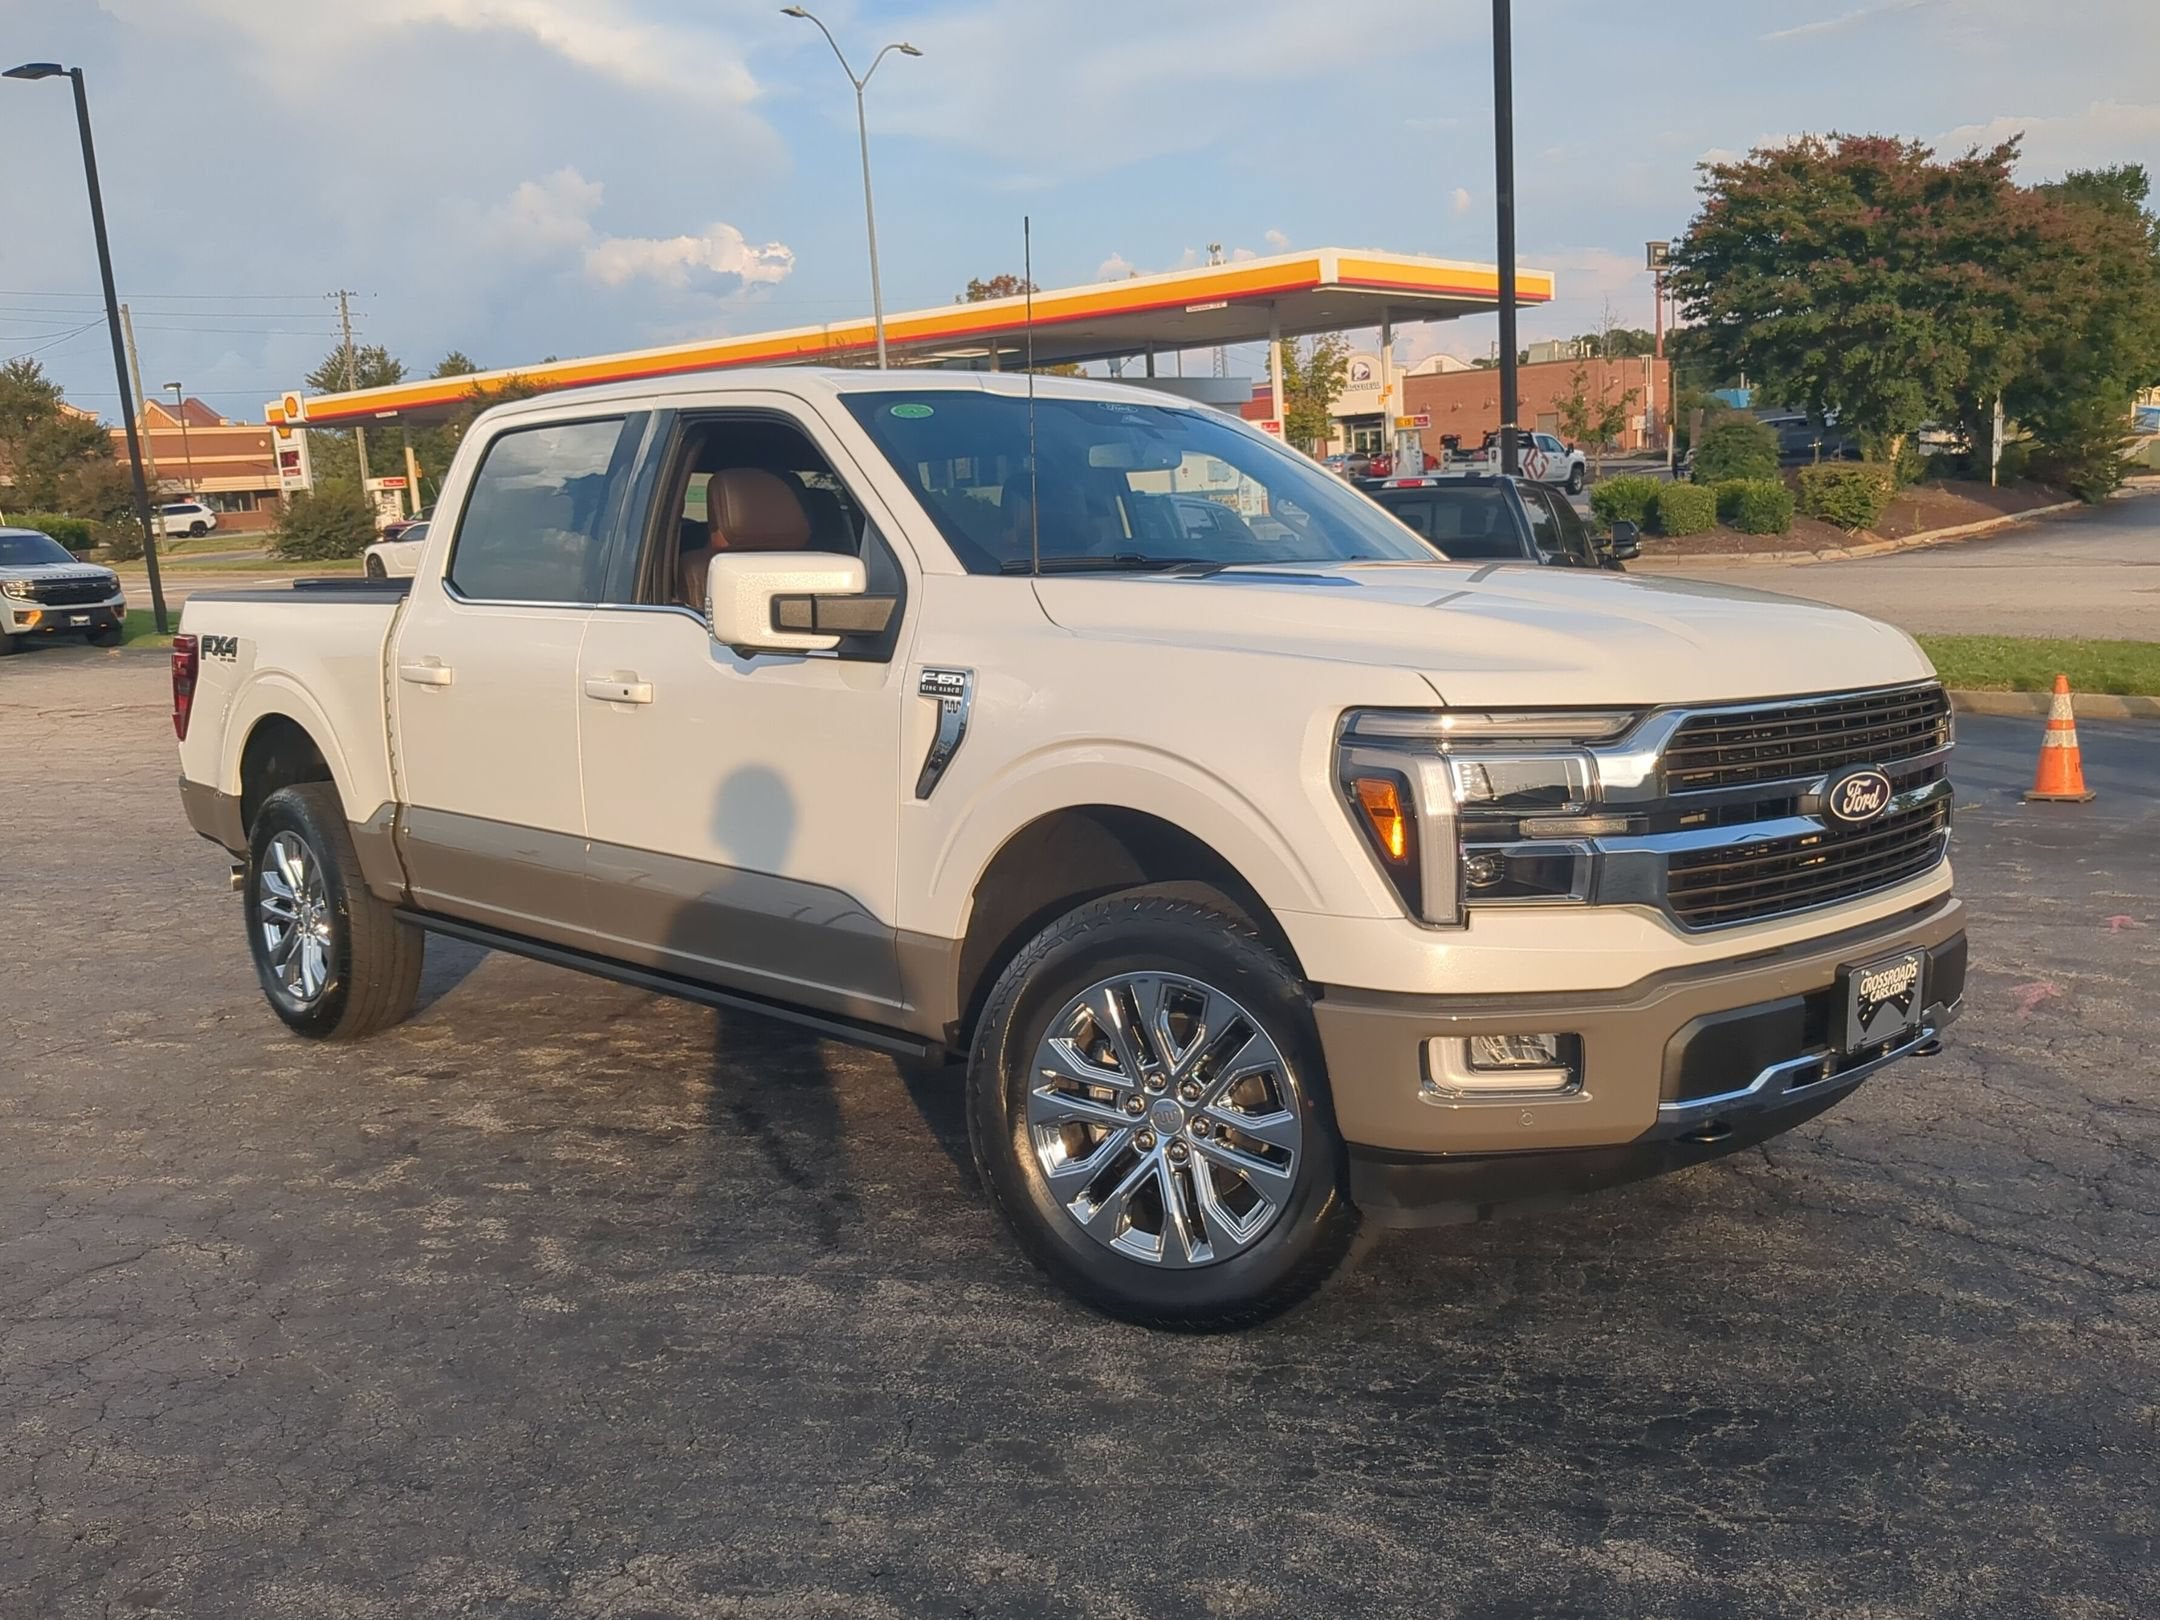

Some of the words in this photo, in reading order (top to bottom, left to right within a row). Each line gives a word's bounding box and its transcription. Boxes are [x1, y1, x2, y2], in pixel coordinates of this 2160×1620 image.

[201, 635, 238, 660] FX4
[922, 672, 965, 686] F-150
[1843, 779, 1880, 814] Ford
[1861, 961, 1918, 995] CROSSROADS
[1870, 980, 1907, 1002] CARS.COM
